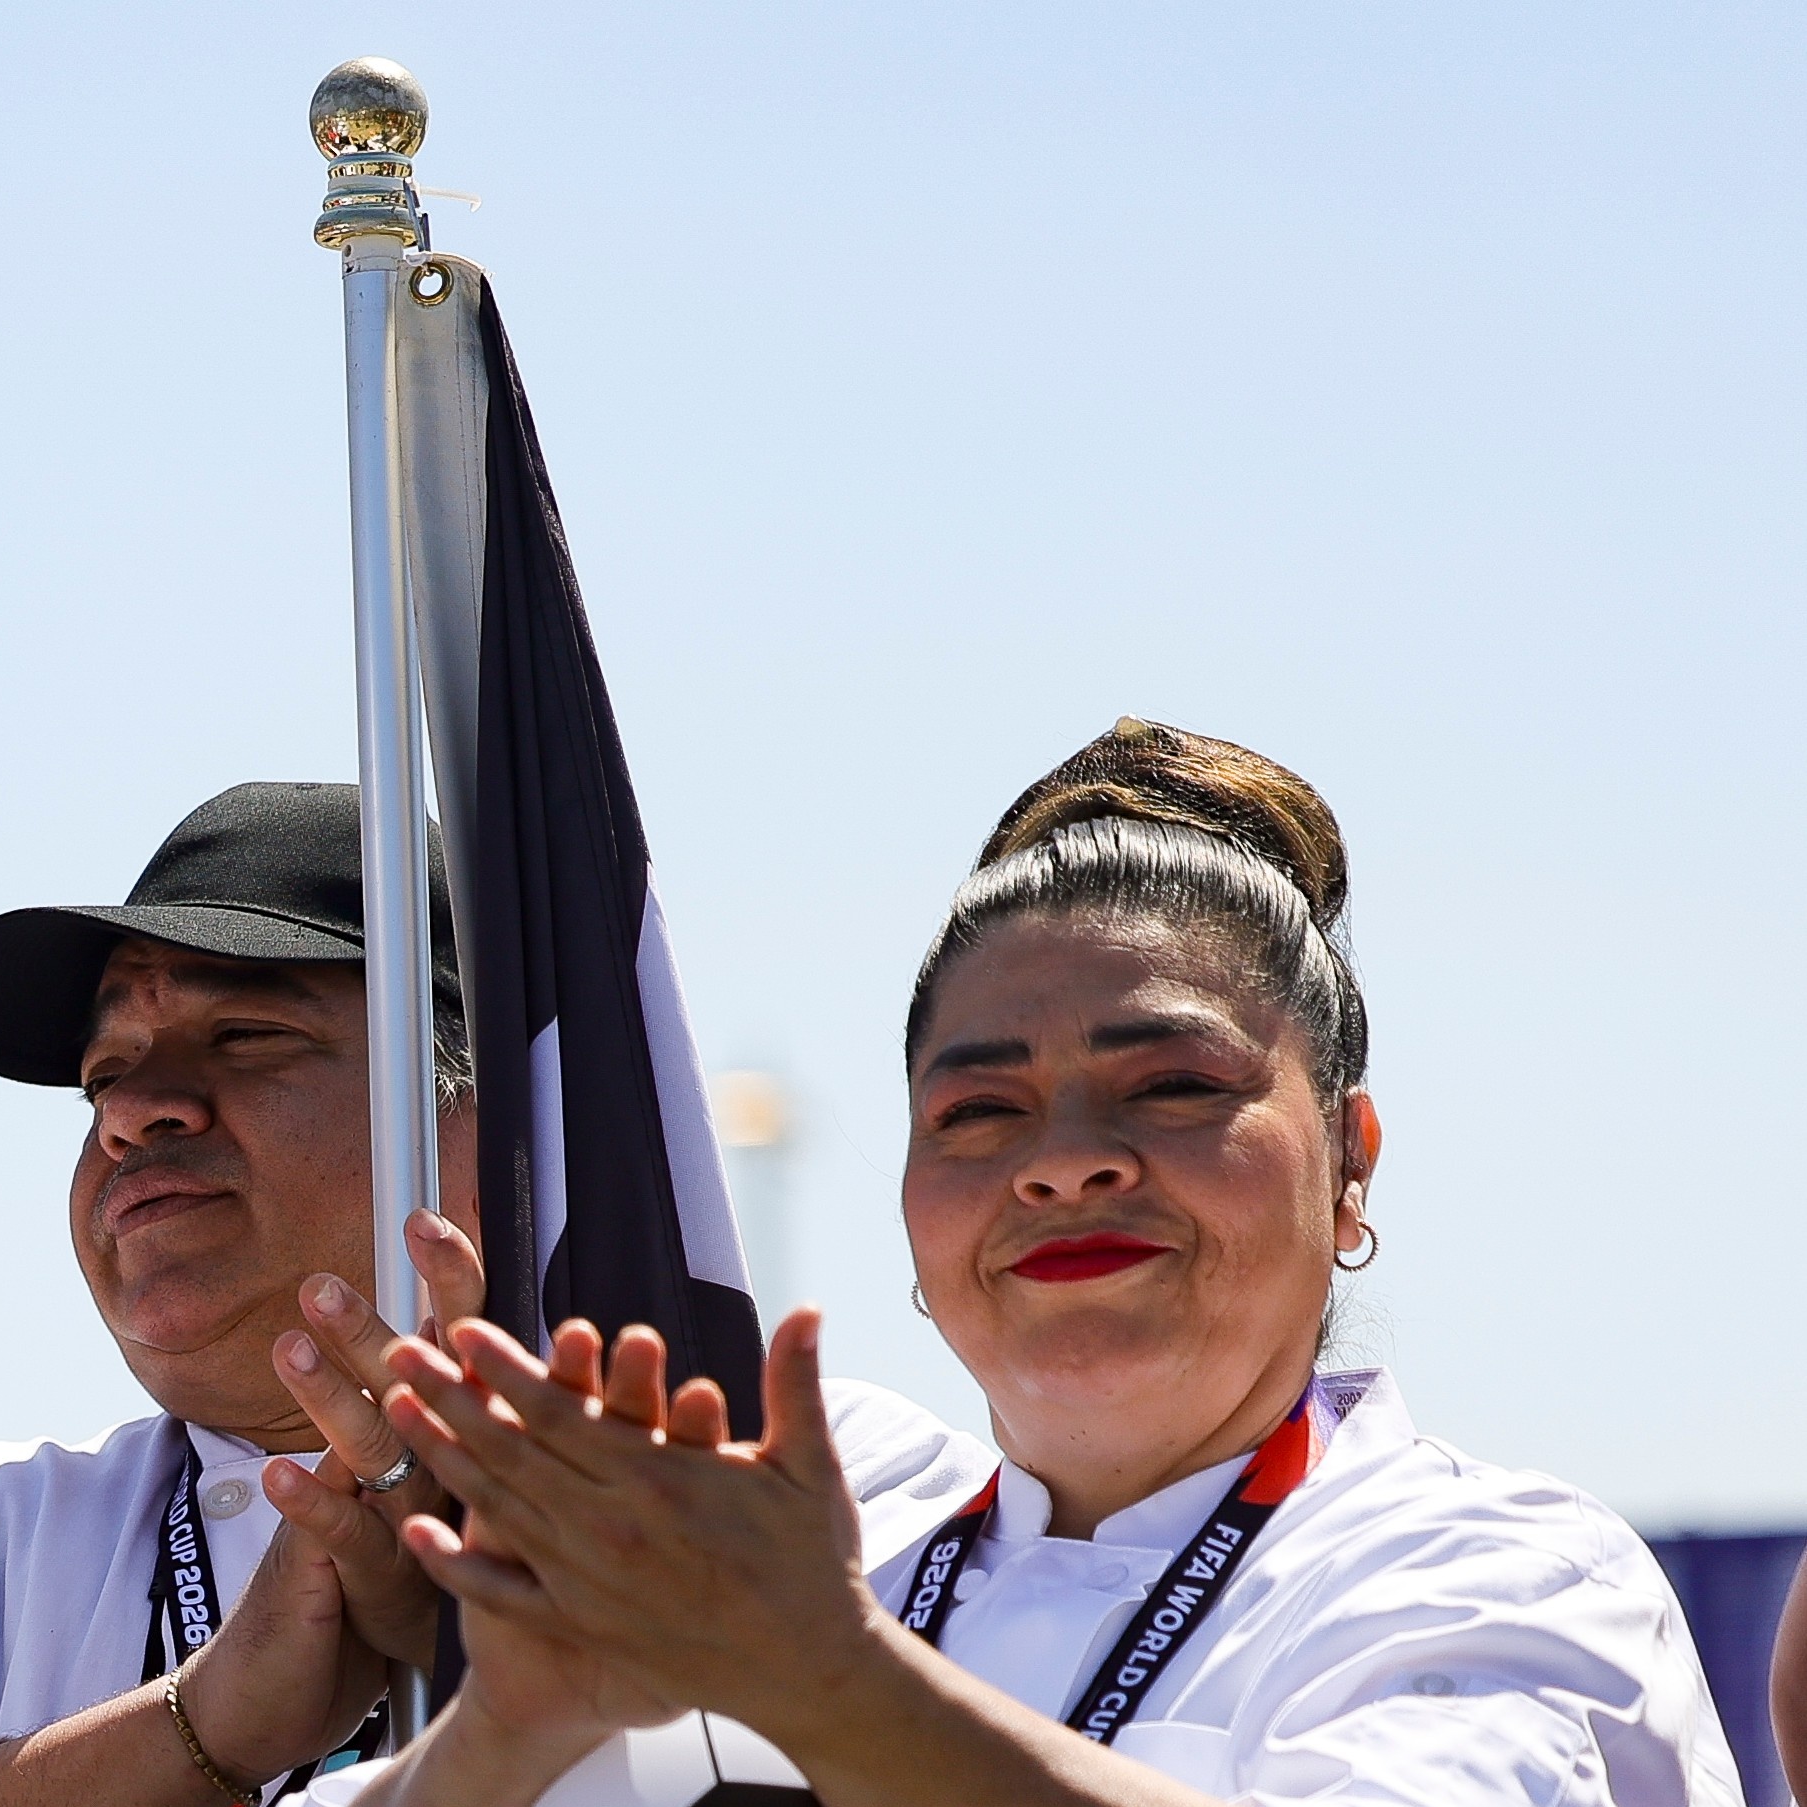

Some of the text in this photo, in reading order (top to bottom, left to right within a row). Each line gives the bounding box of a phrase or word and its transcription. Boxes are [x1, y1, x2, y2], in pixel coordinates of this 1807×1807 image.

[168, 1523, 197, 1564] CUP
[1183, 1522, 1244, 1580] FIFA
[174, 1565, 212, 1645] 2026
[905, 1541, 961, 1629] 2026
[1116, 1583, 1204, 1687] WORLD
